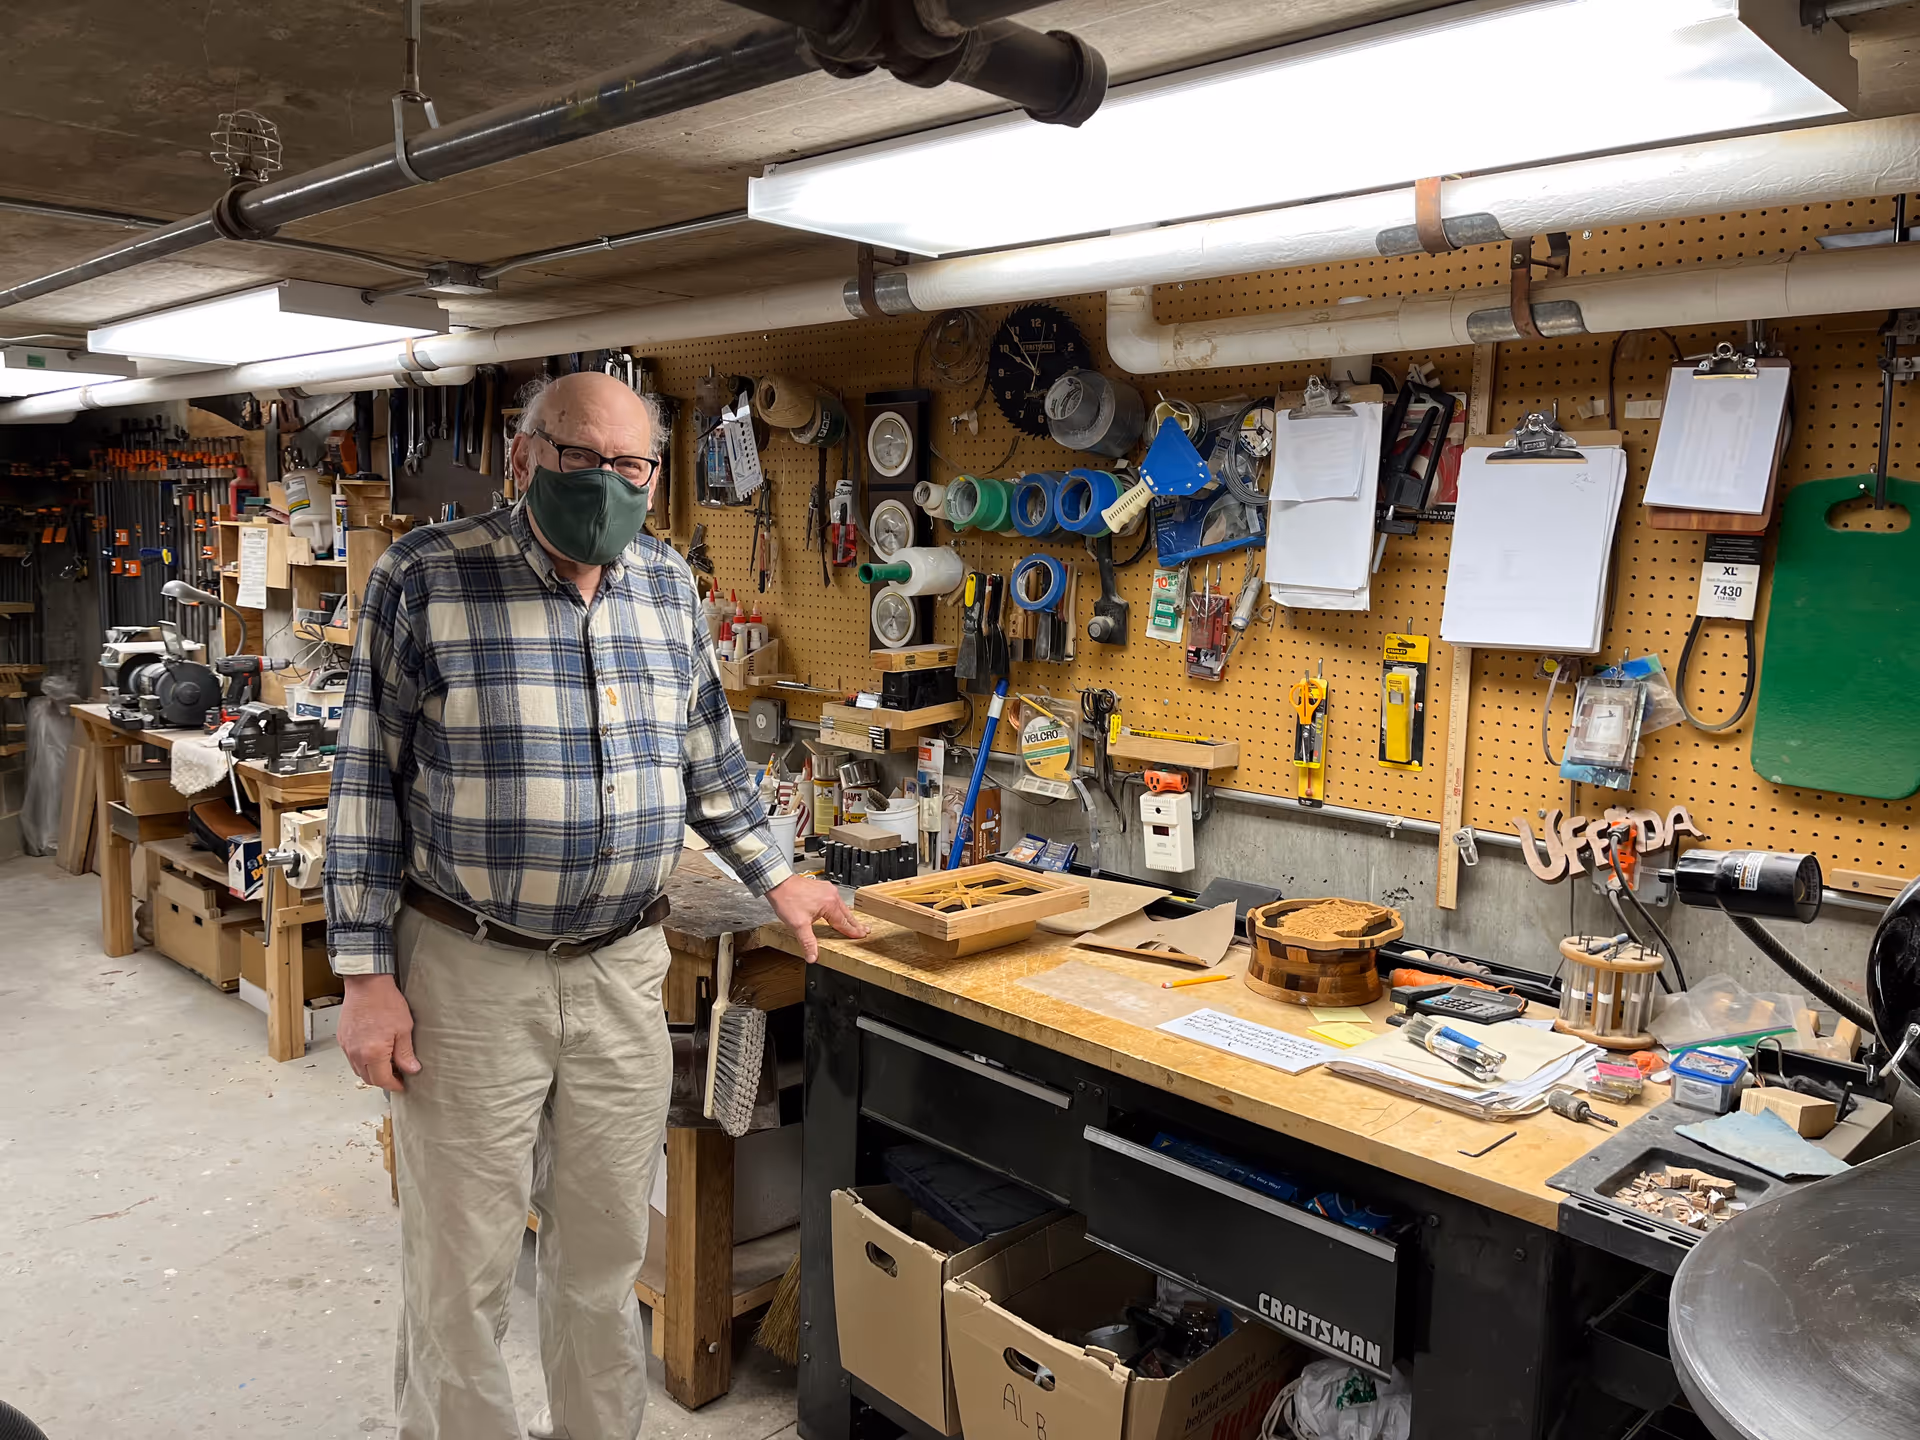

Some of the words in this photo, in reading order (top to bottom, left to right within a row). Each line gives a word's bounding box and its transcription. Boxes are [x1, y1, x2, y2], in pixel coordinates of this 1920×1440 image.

[1031, 318, 1042, 328] 12
[1052, 324, 1057, 333] 1
[1000, 344, 1010, 353] 10
[1067, 342, 1075, 352] 2
[998, 368, 1005, 377] 9
[1005, 391, 1012, 400] 8
[1019, 410, 1025, 419] 7
[1037, 414, 1045, 424] 6
[1155, 576, 1168, 589] 10
[1713, 584, 1743, 598] 7430
[1258, 1293, 1381, 1366] CRAFTSMAN
